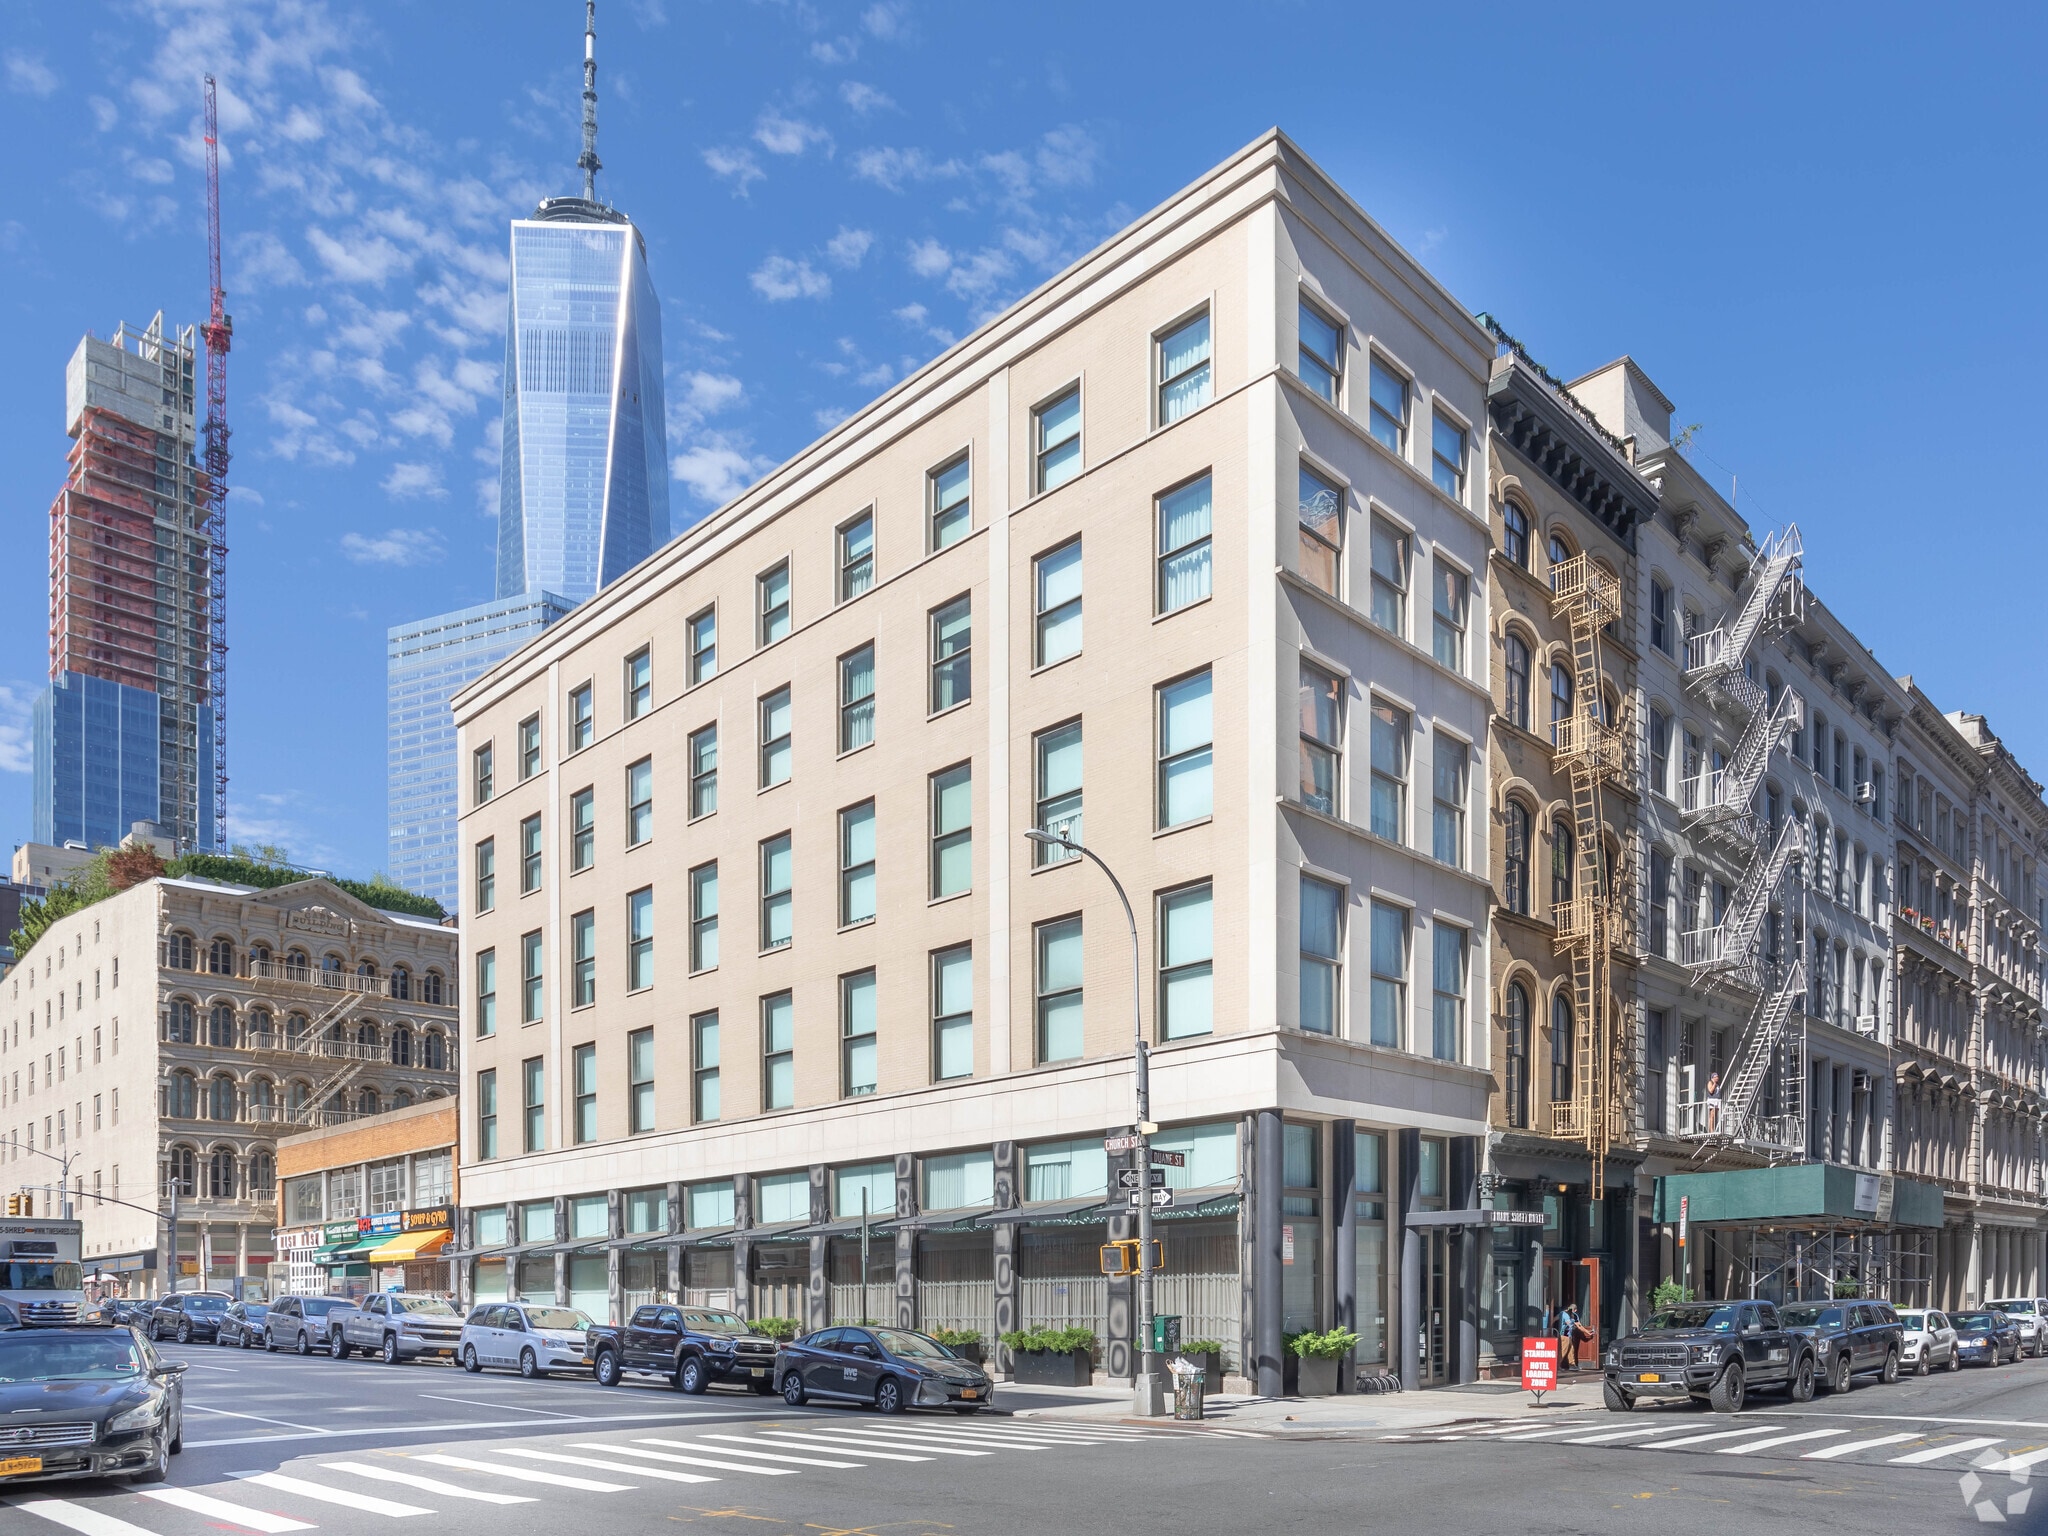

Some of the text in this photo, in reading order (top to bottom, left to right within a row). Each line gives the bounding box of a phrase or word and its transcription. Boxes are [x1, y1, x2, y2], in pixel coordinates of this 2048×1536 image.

[1105, 1136, 1138, 1151] CHURCH ST
[1153, 1152, 1182, 1166] DUANE ST
[1125, 1175, 1138, 1183] ONE
[1153, 1193, 1166, 1201] WAY
[410, 1213, 426, 1227] SOUP
[425, 1212, 431, 1224] &
[430, 1210, 447, 1226] GYRO
[1535, 1341, 1545, 1350] NO
[1524, 1350, 1556, 1358] STANDING
[1530, 1361, 1549, 1370] HOTEL
[843, 1367, 858, 1377] NYC
[1525, 1370, 1553, 1378] LOADING
[1531, 1378, 1547, 1387] ZONE
